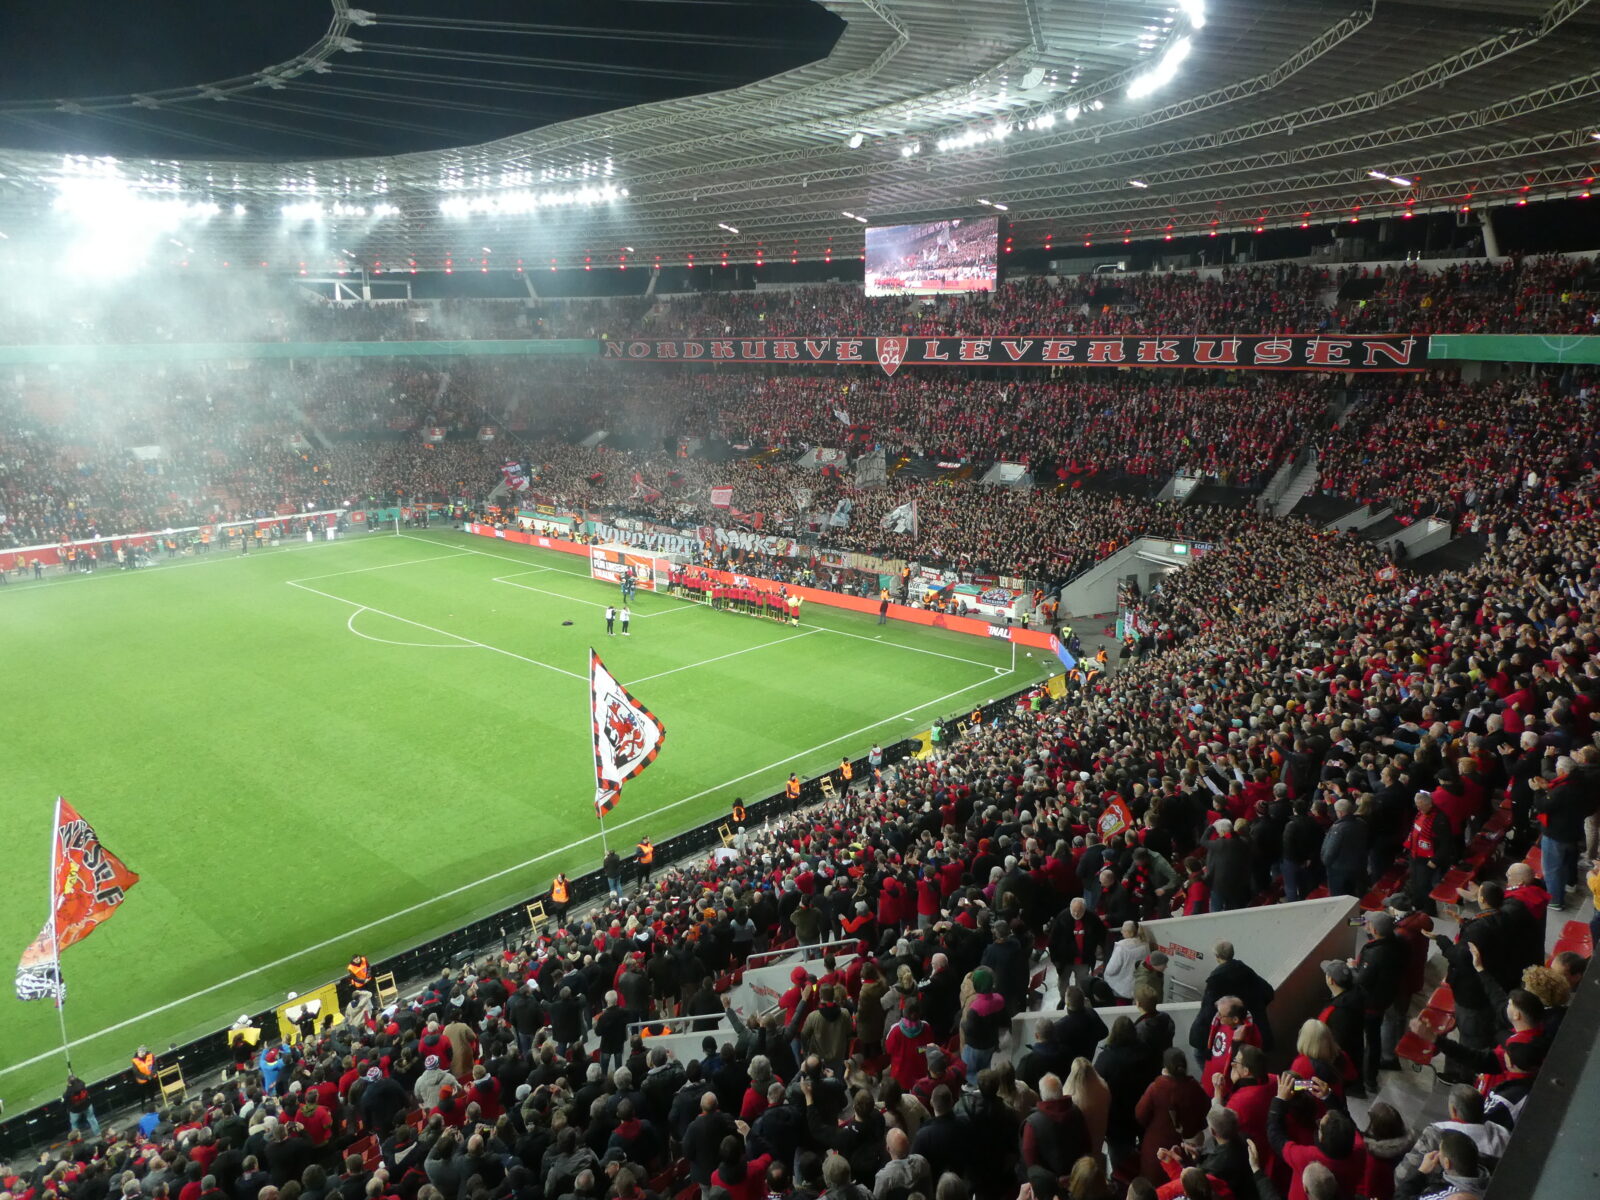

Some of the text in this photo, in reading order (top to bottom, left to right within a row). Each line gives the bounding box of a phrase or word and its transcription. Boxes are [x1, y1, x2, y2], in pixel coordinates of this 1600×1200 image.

[604, 340, 863, 362] NORDKURVE
[880, 353, 900, 365] 04
[923, 339, 1417, 366] LEVERKUSEN
